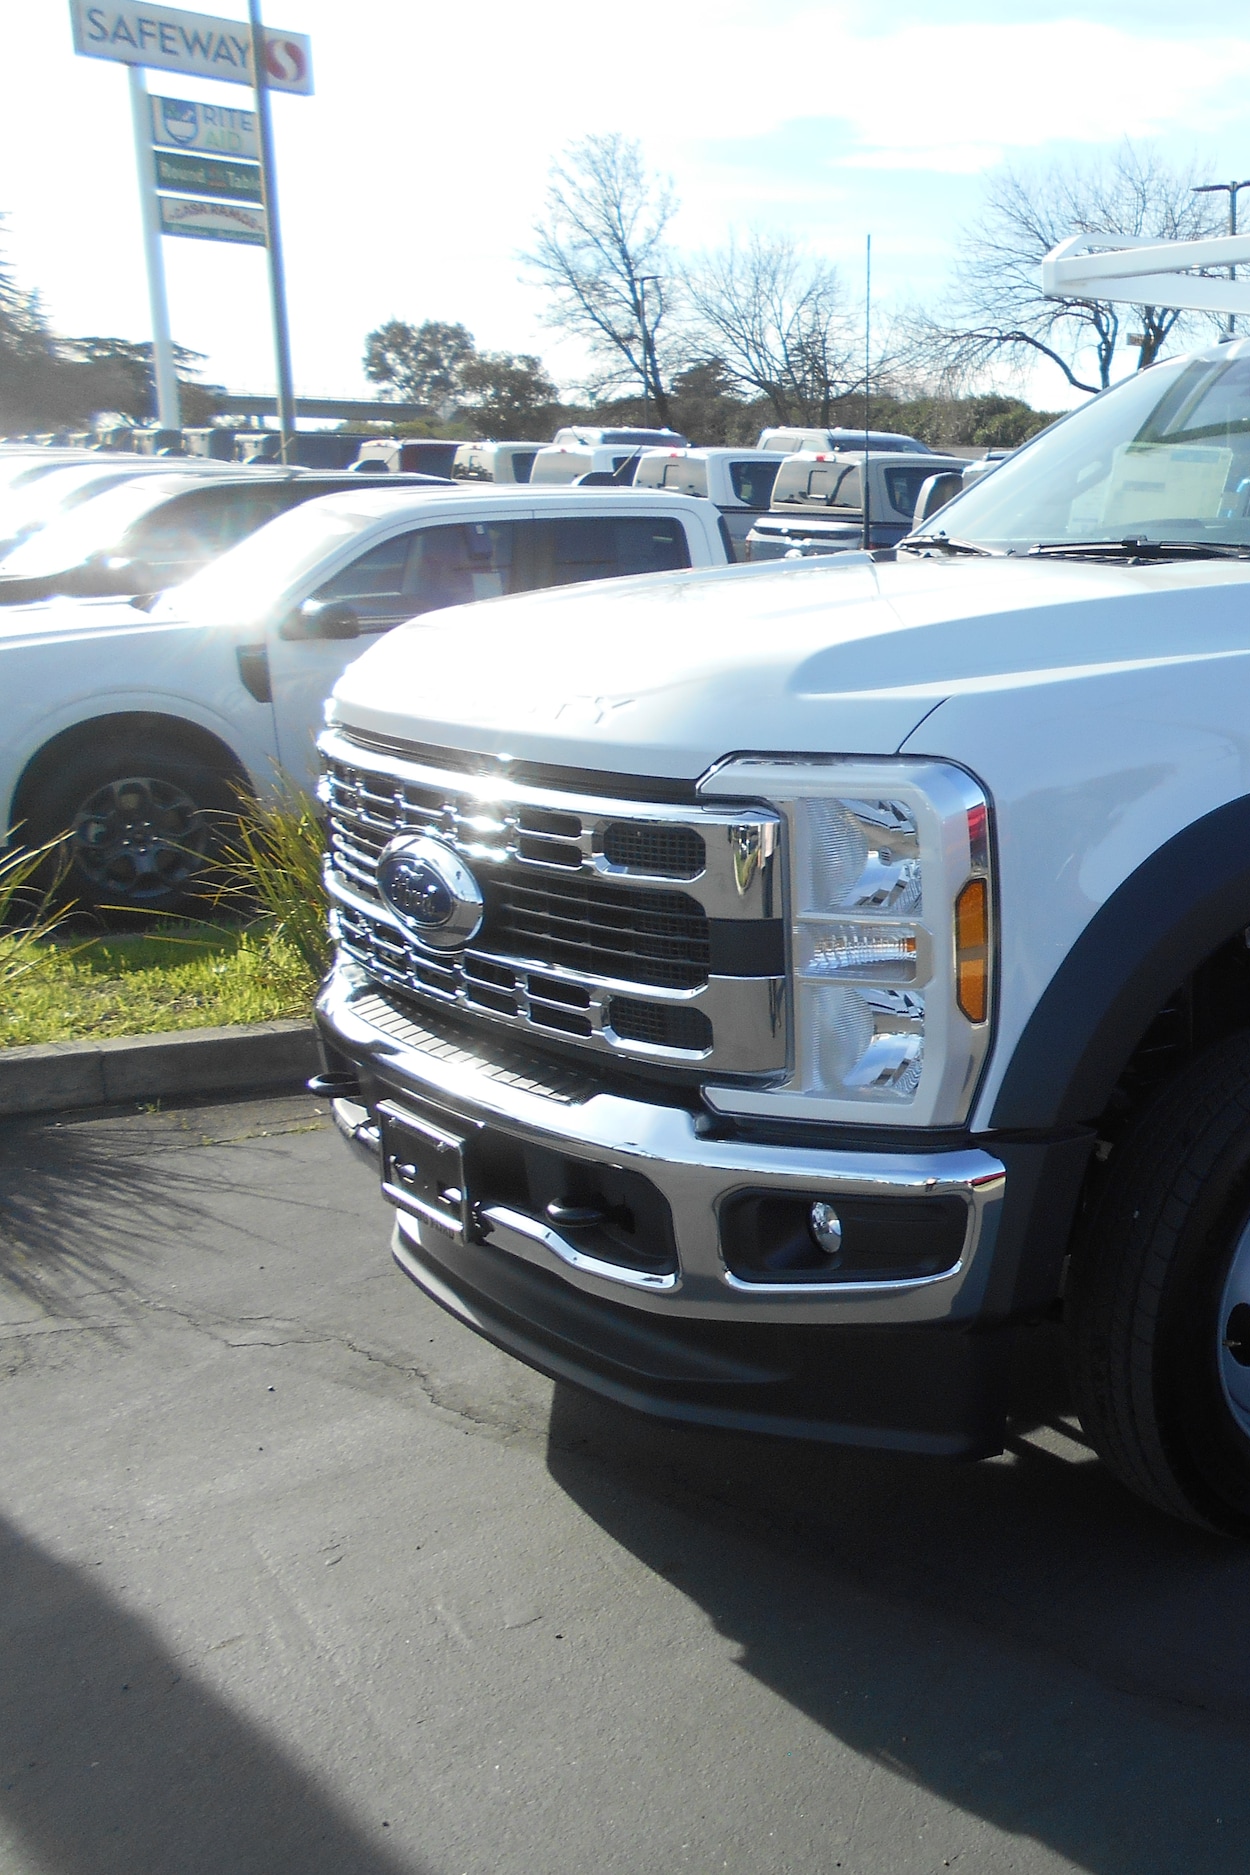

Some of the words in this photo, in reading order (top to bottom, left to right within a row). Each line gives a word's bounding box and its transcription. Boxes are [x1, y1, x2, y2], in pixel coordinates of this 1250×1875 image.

[86, 9, 252, 69] SAFEWAY
[202, 102, 254, 132] RITE
[204, 130, 243, 151] AID
